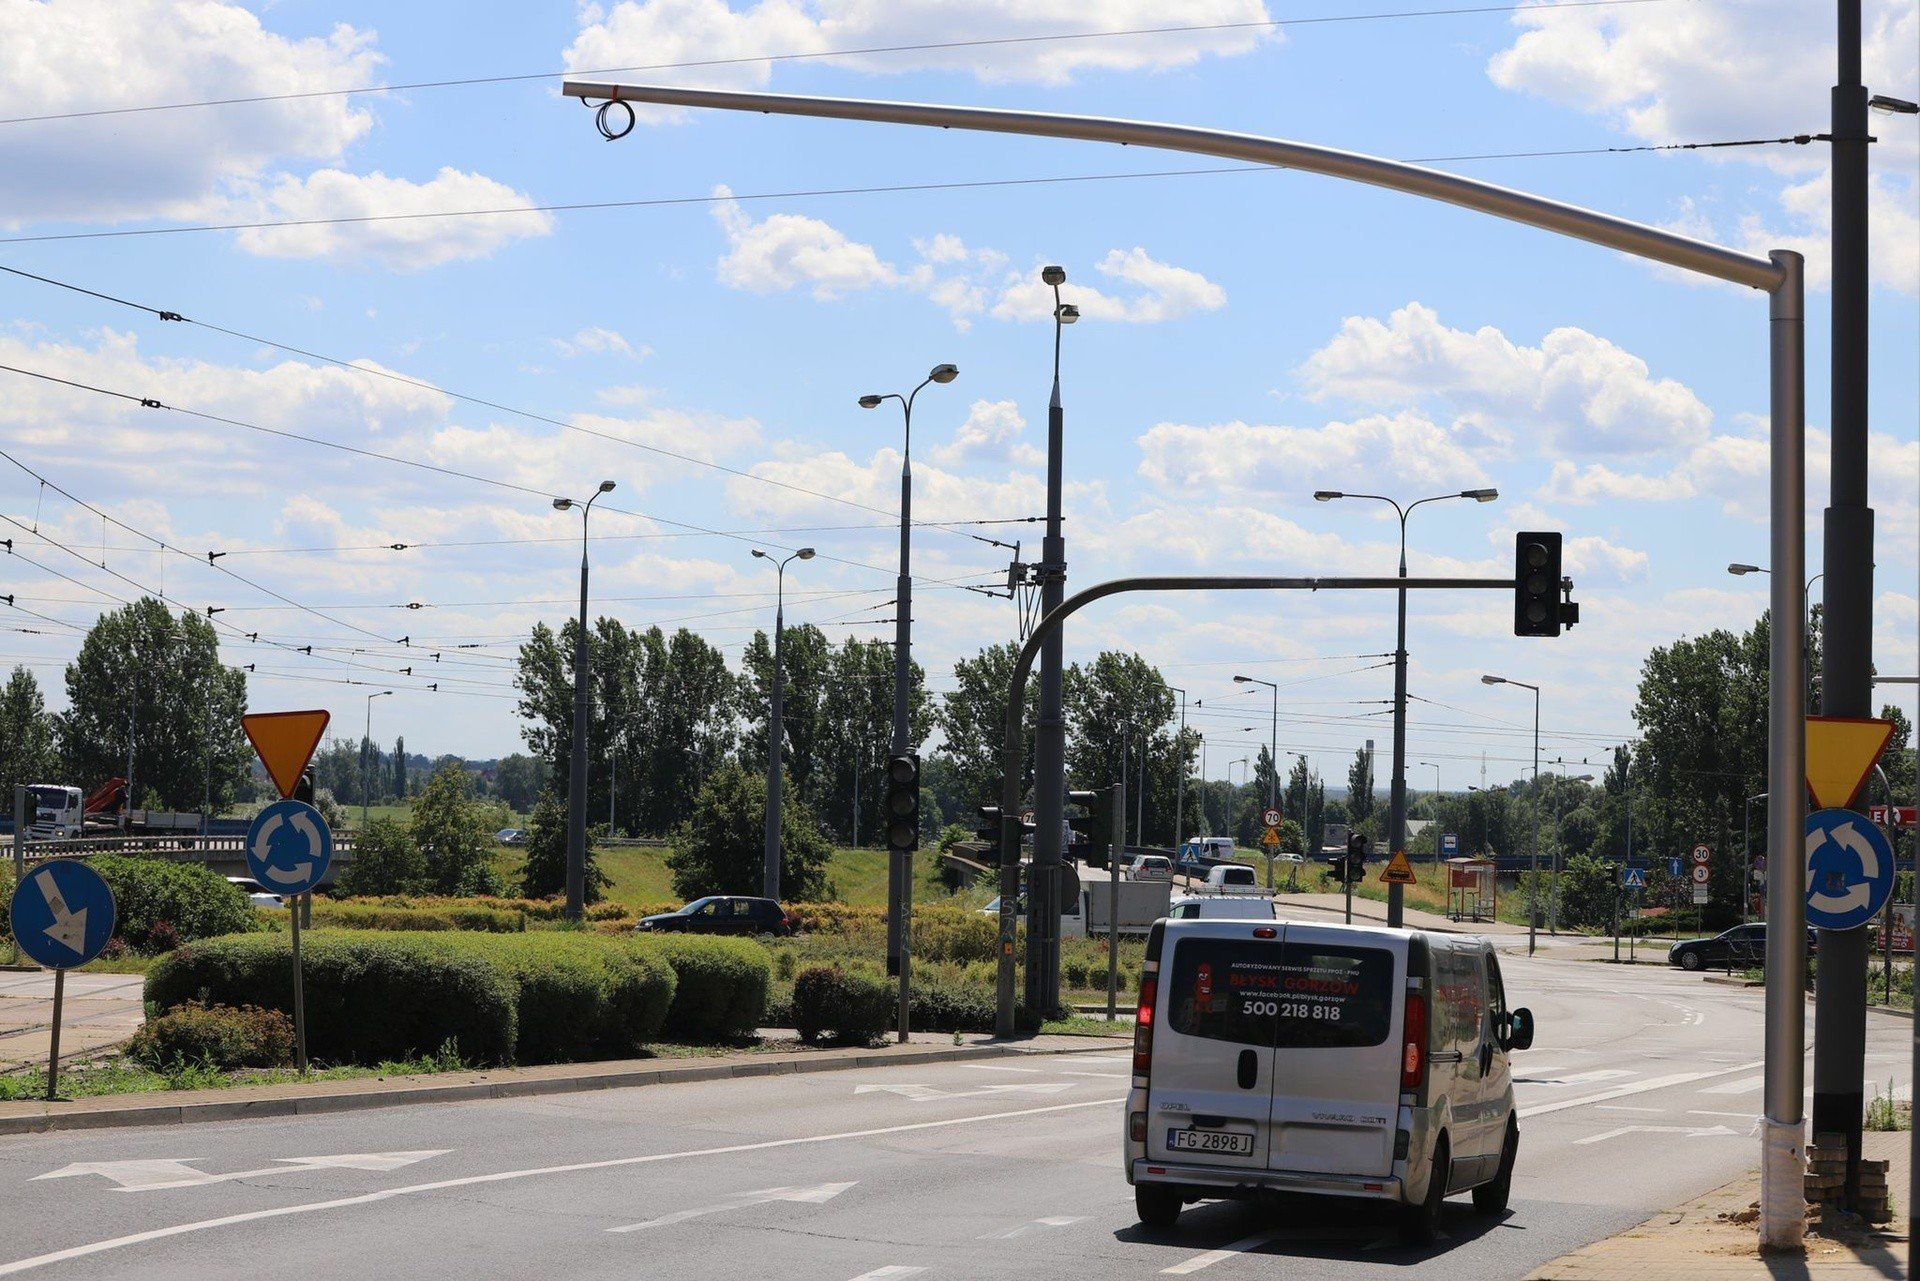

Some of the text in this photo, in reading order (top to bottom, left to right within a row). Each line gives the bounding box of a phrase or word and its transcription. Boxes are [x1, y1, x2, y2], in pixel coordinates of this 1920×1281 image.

[1267, 813, 1279, 823] 70
[1695, 849, 1708, 859] 30
[1231, 962, 1281, 971] AUTORYZOWANY
[1242, 1001, 1341, 1020] 500 218 818
[1178, 1131, 1198, 1148] FG
